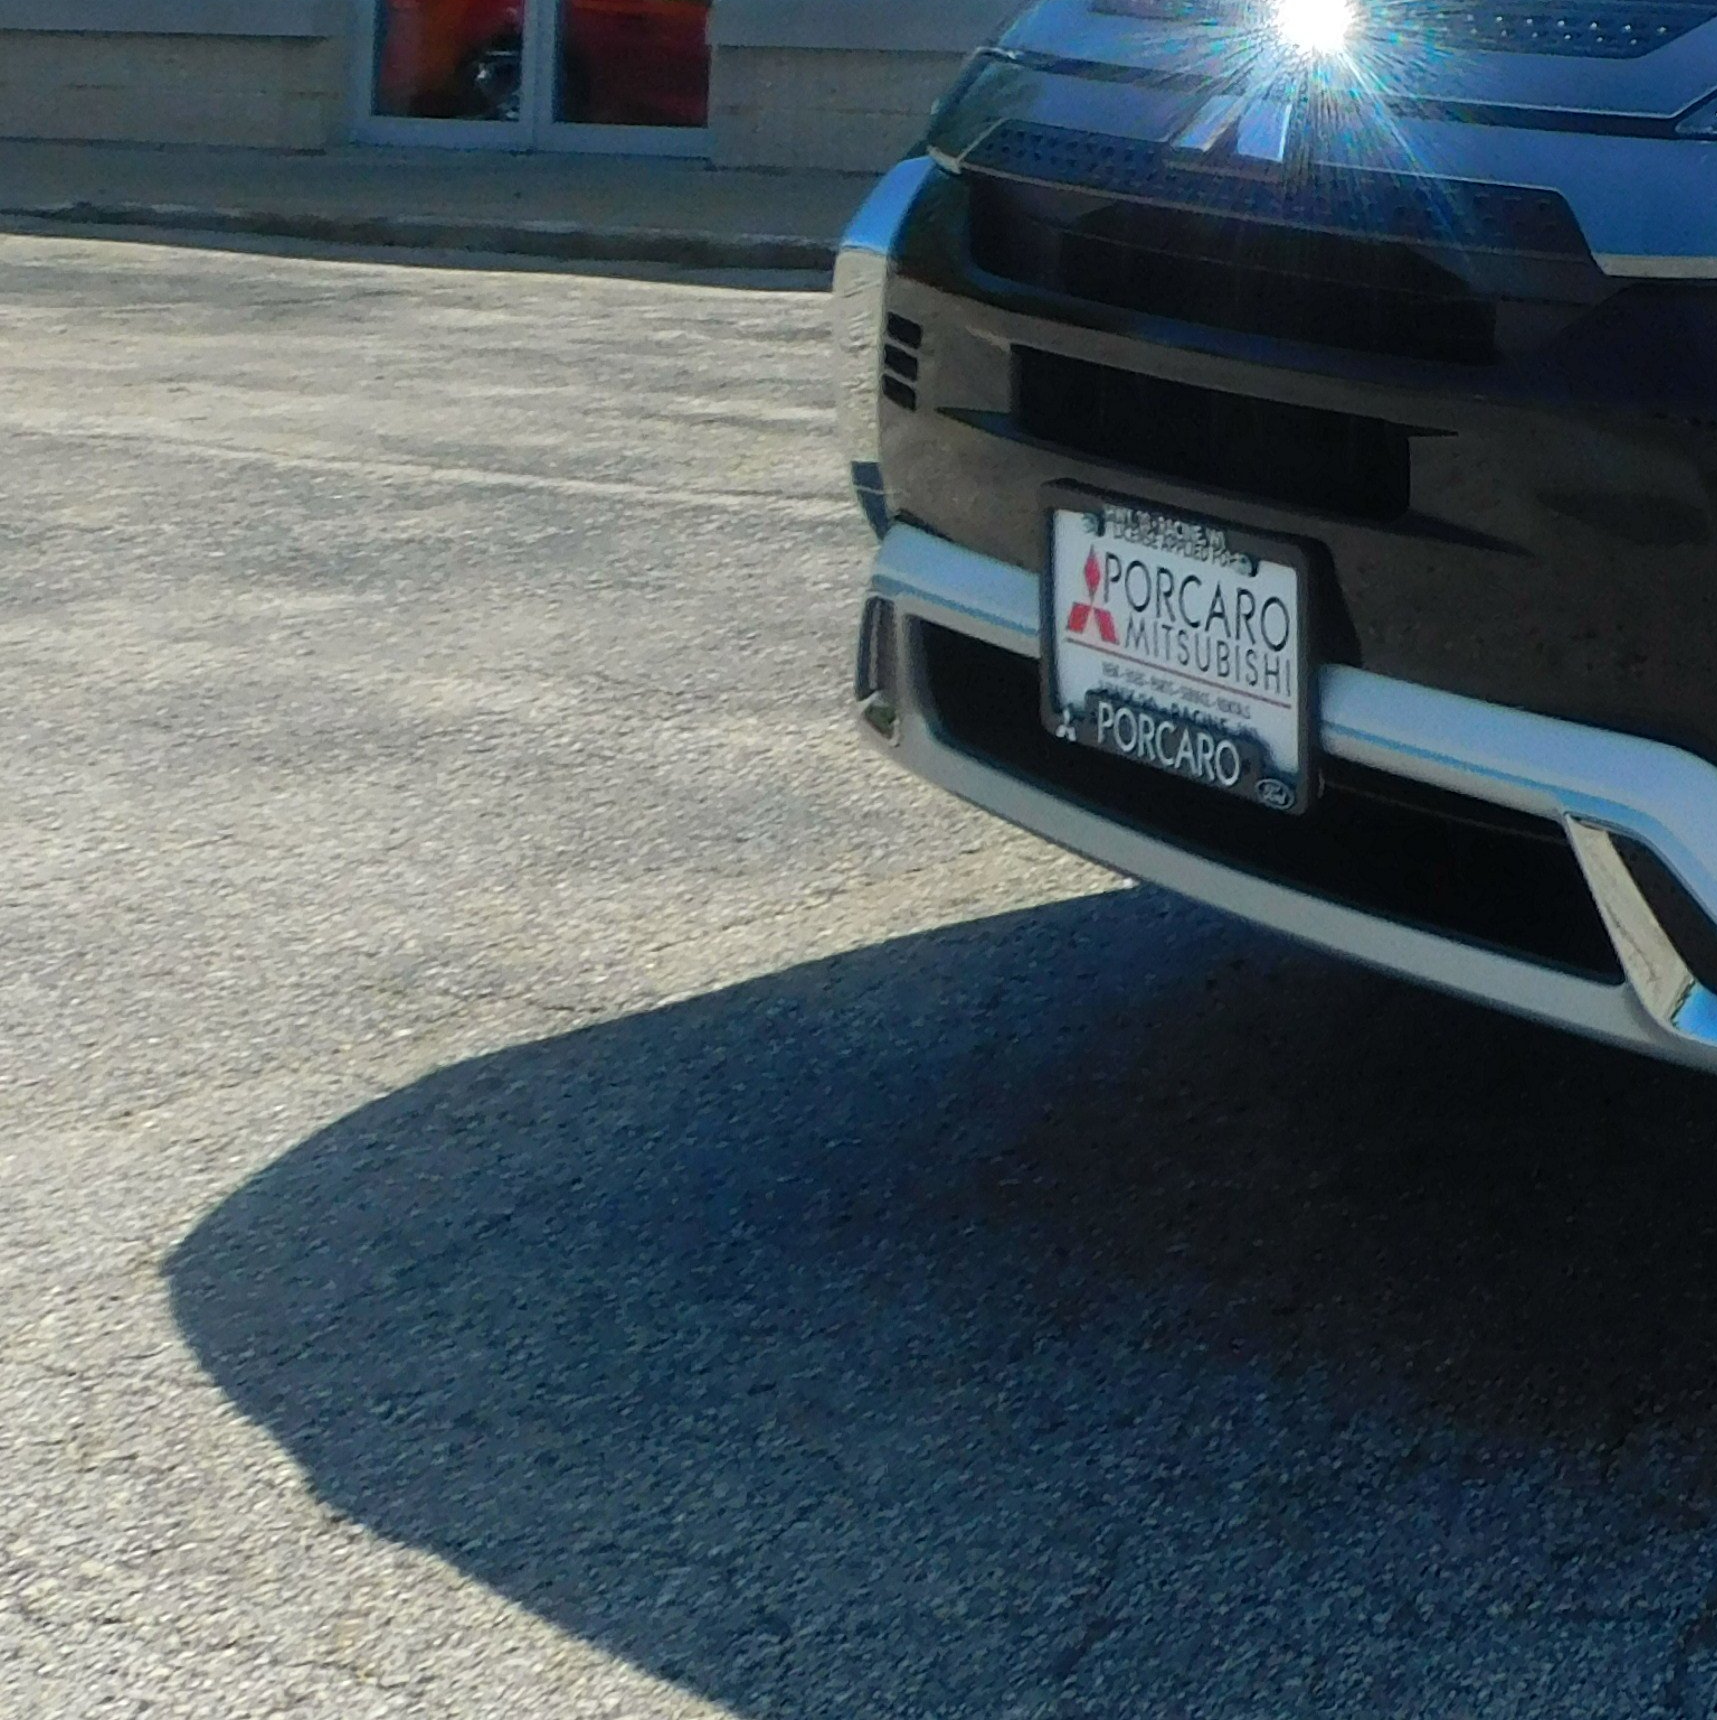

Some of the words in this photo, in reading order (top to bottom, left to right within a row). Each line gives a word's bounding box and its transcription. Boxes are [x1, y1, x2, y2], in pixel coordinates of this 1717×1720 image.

[1104, 551, 1290, 652] PORCARO
[1124, 614, 1292, 697] MITSUBISHI
[1097, 700, 1240, 786] PORCARO
